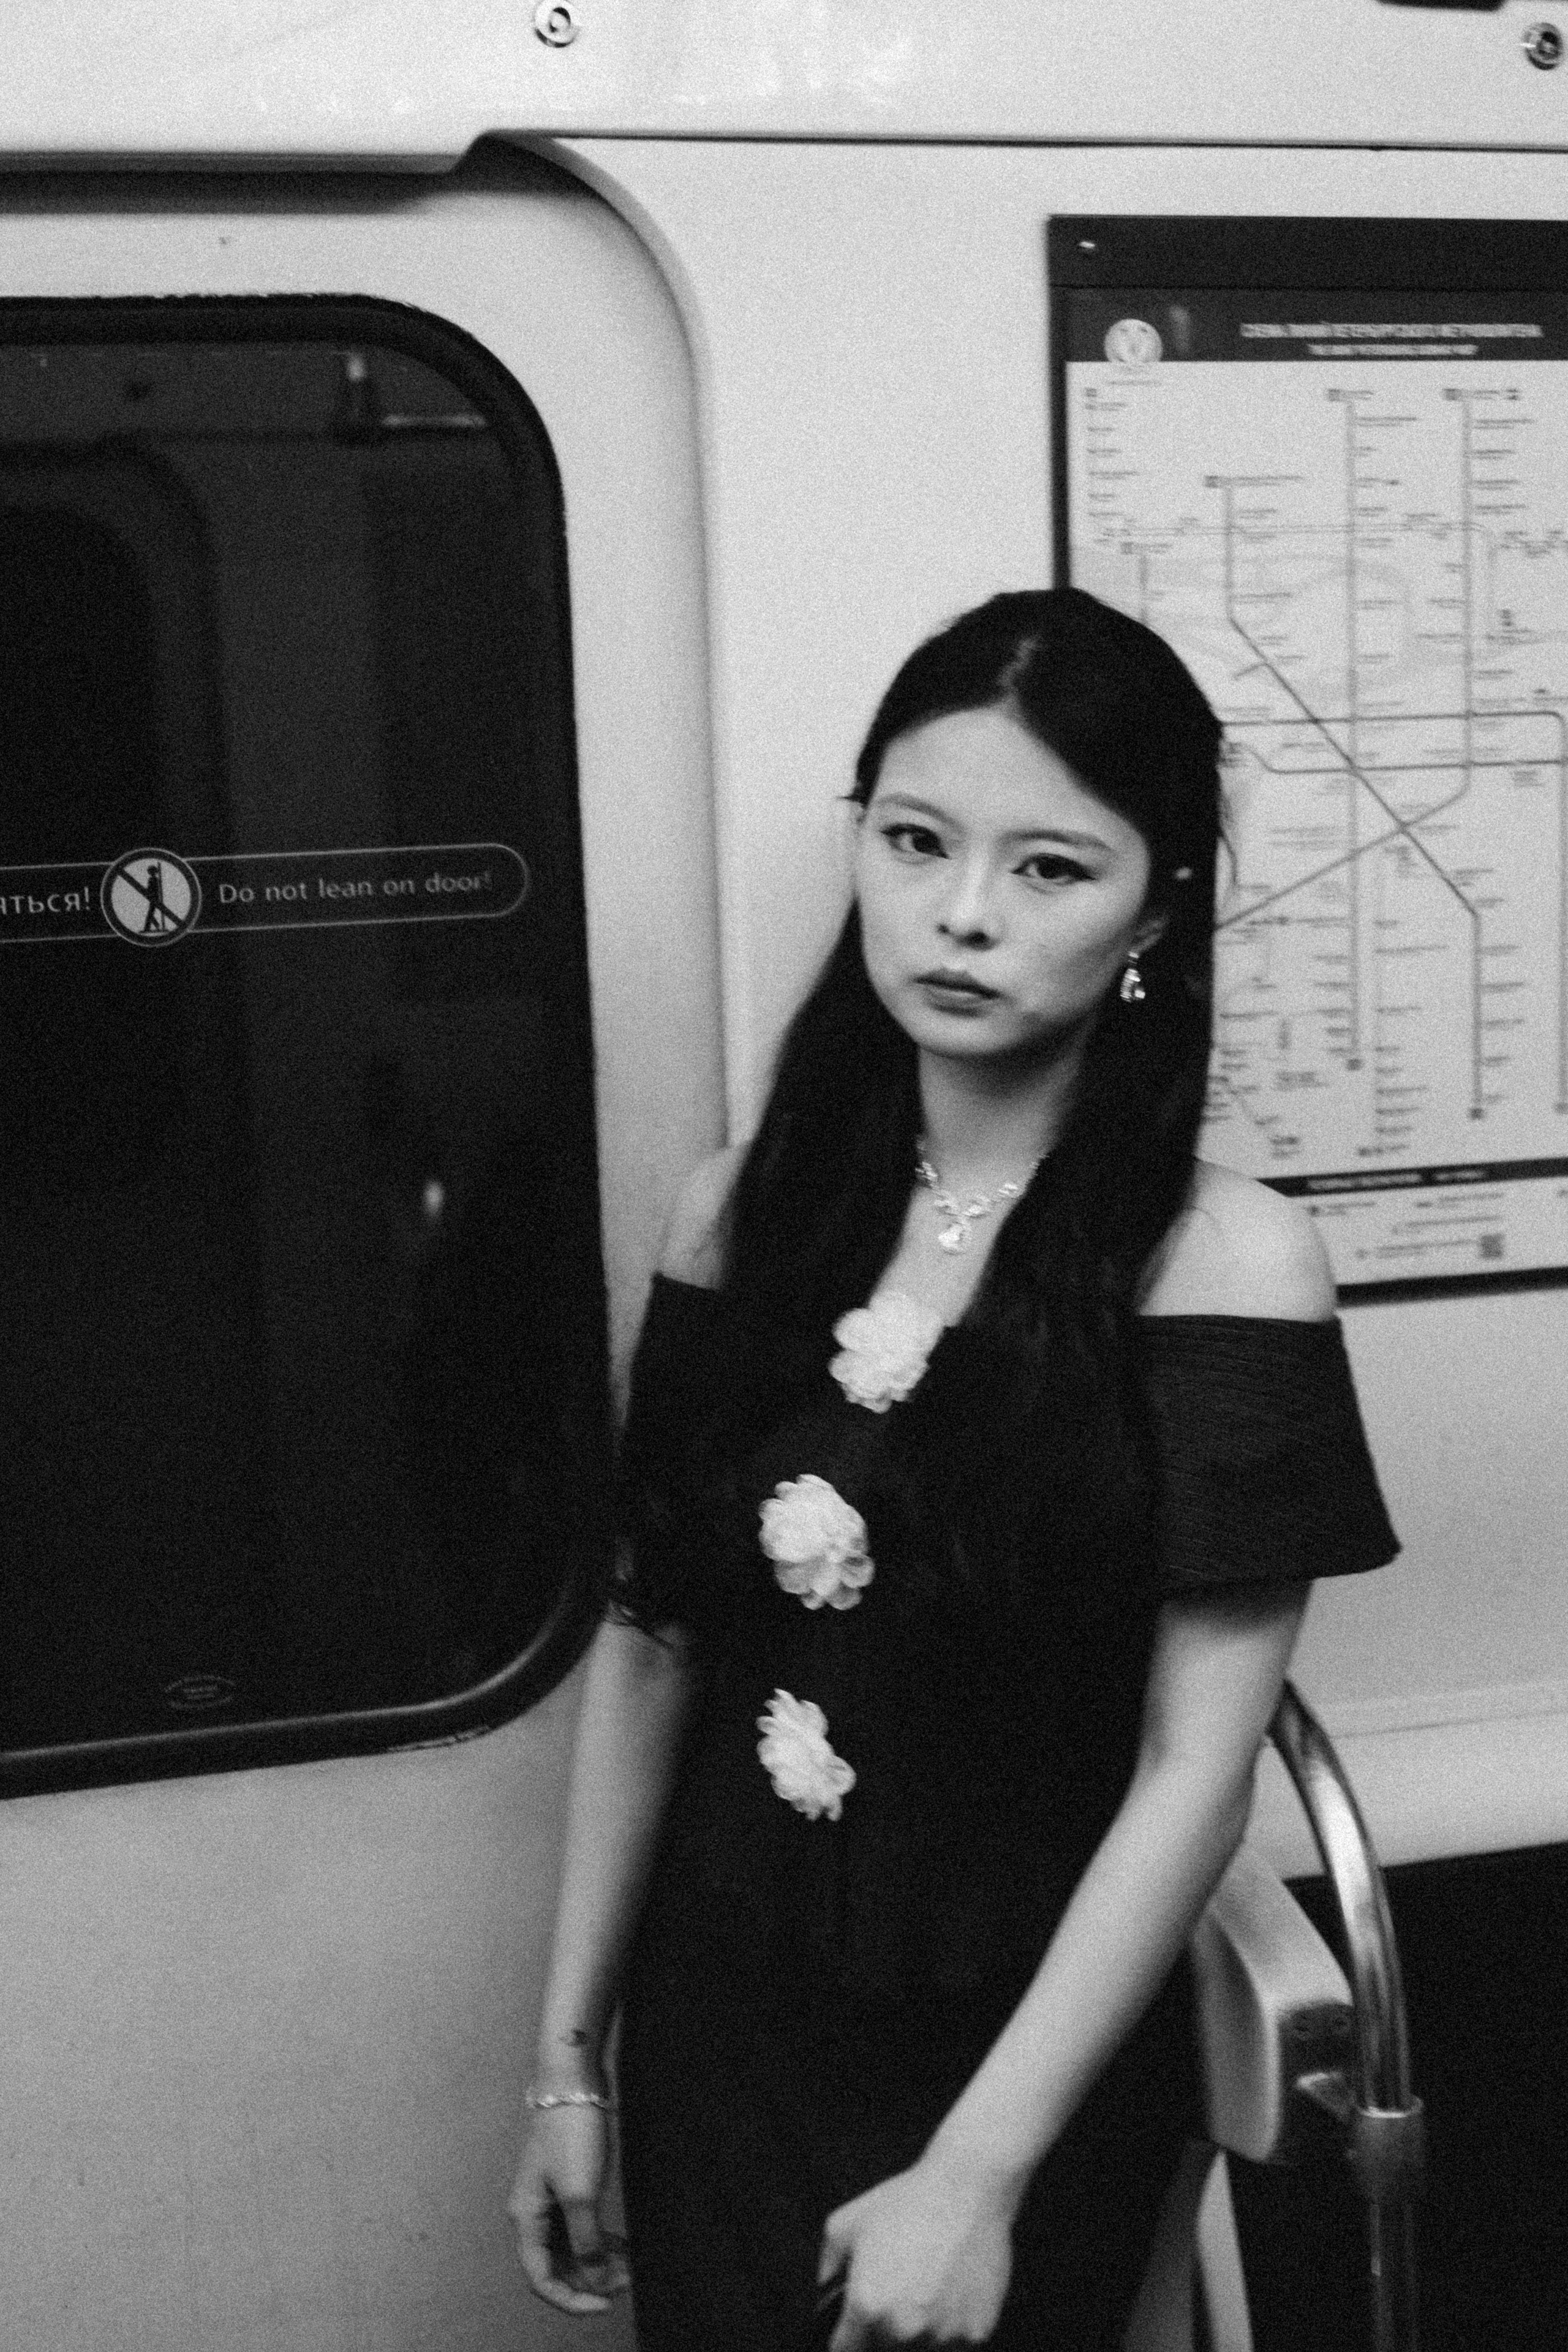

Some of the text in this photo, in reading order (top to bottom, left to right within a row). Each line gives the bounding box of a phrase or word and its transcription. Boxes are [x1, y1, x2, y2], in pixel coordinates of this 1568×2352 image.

[219, 883, 255, 903] Do
[265, 882, 307, 901] not
[319, 877, 372, 899] lean
[383, 879, 415, 897] on
